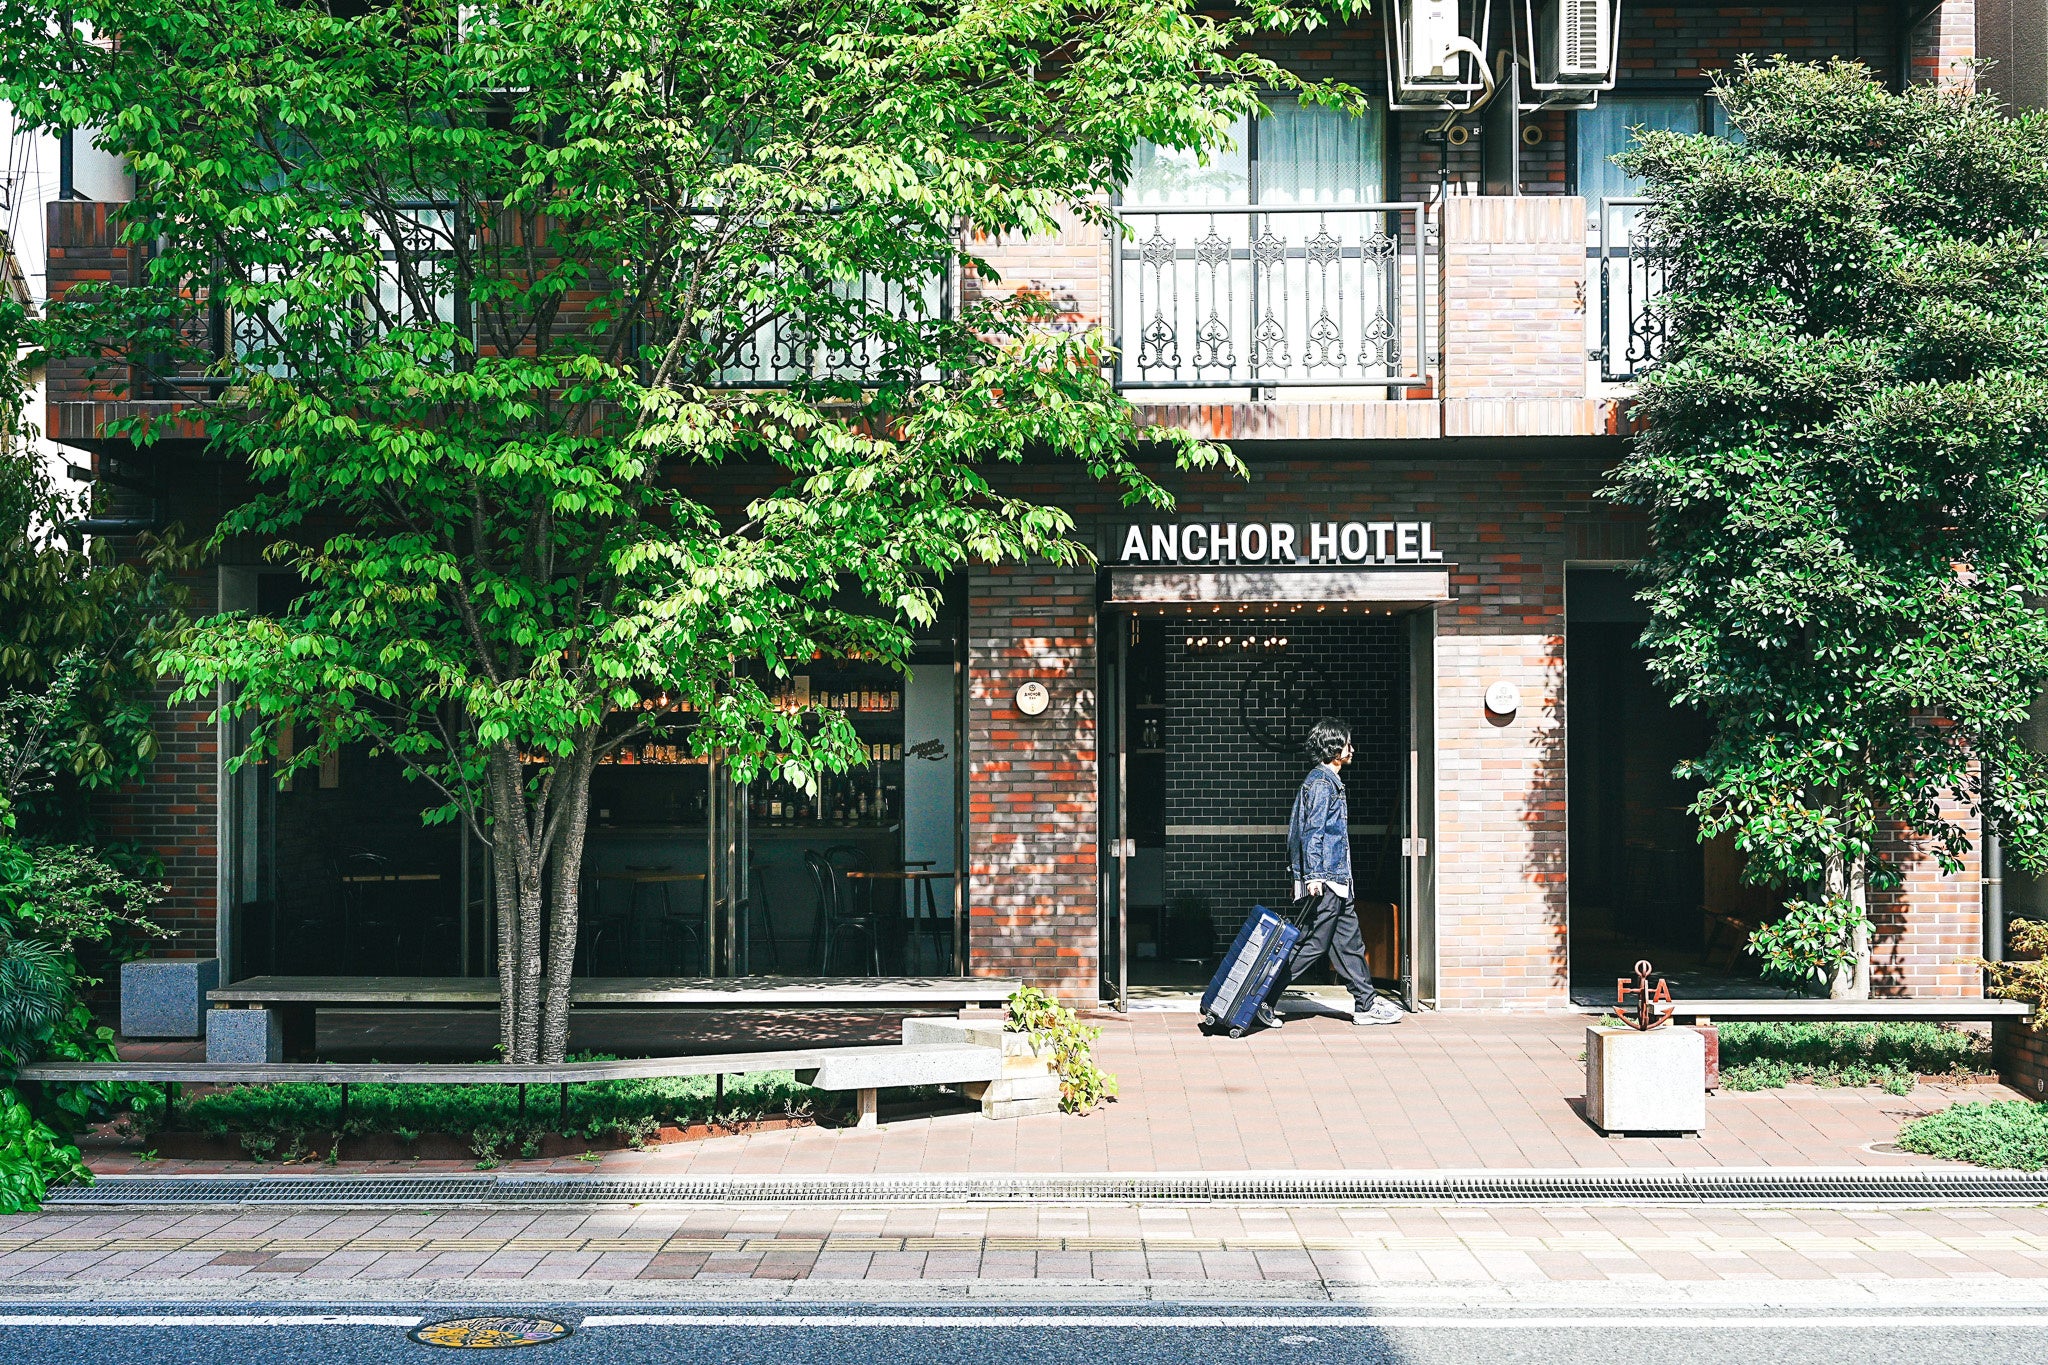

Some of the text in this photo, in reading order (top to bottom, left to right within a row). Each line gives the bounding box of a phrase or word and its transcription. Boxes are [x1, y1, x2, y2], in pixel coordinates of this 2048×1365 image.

[1120, 521, 1443, 561] ANCHOR HOTEL
[1617, 977, 1672, 1003] F A
